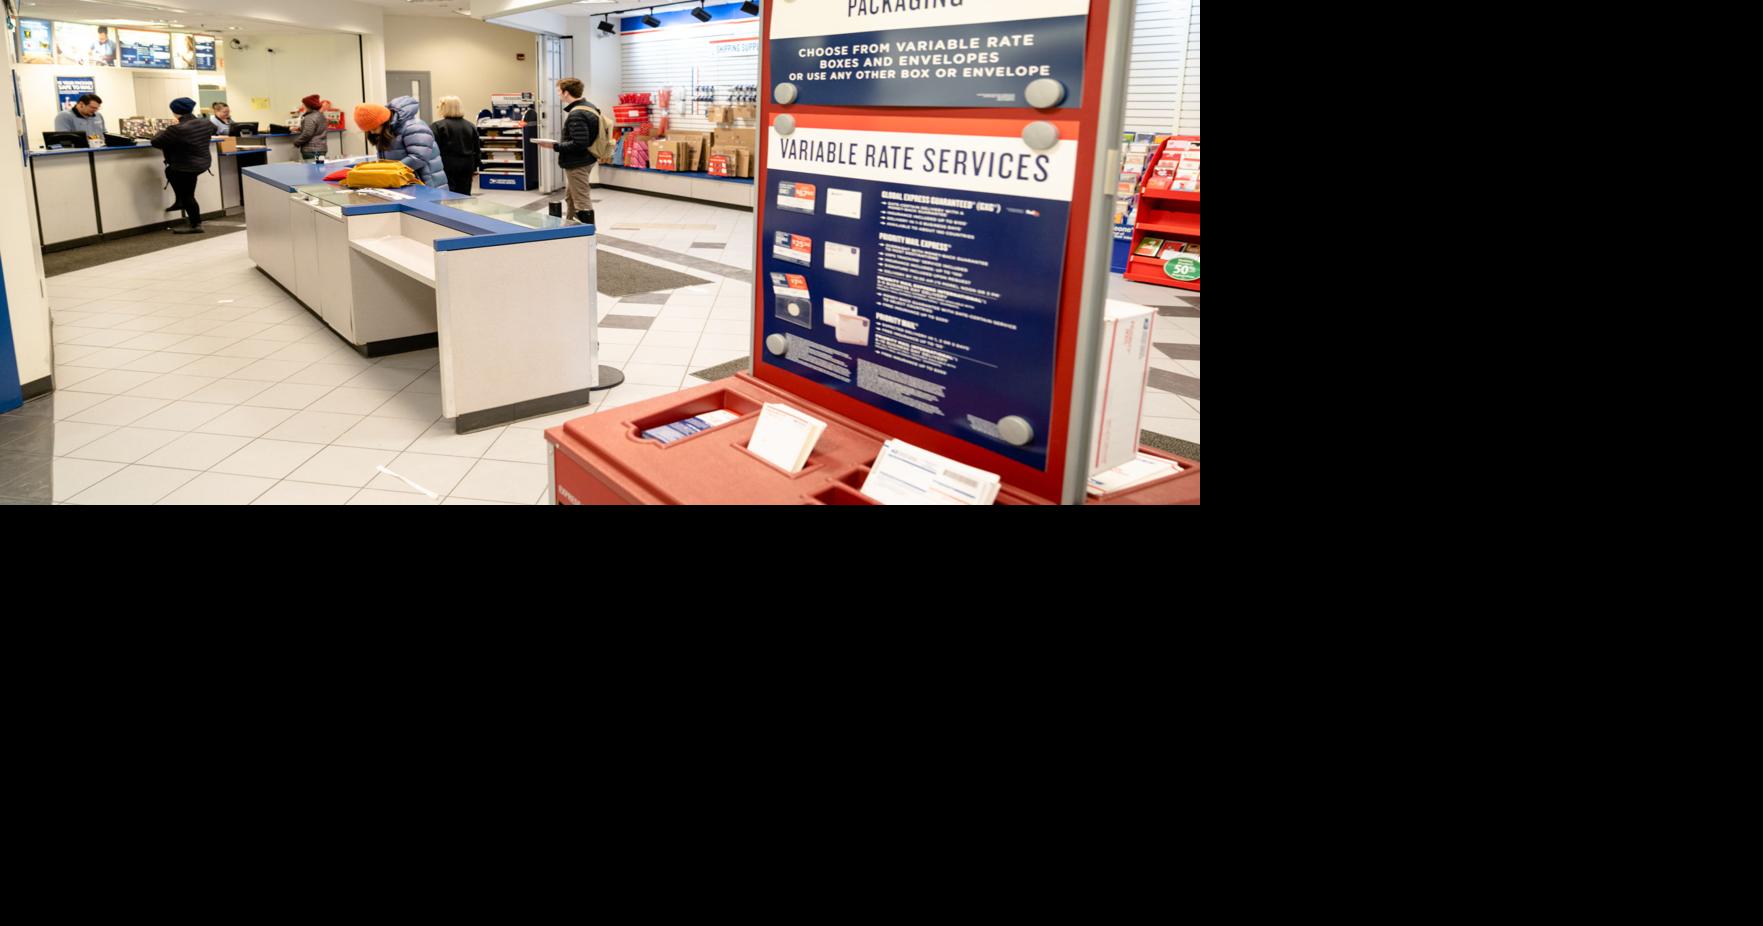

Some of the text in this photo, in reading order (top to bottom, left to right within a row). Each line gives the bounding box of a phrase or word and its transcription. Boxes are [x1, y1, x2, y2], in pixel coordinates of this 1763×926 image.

[848, 0, 962, 17] PACKAG
[799, 34, 1034, 57] CHOOSE FROM VARIABLE RATE
[820, 52, 999, 69] BOXES AND ENVELOPES
[789, 65, 1050, 80] OR USE ANY OTHER BOX OR ENVELOPE
[780, 138, 1050, 182] VARIABLE RATE SERVICES
